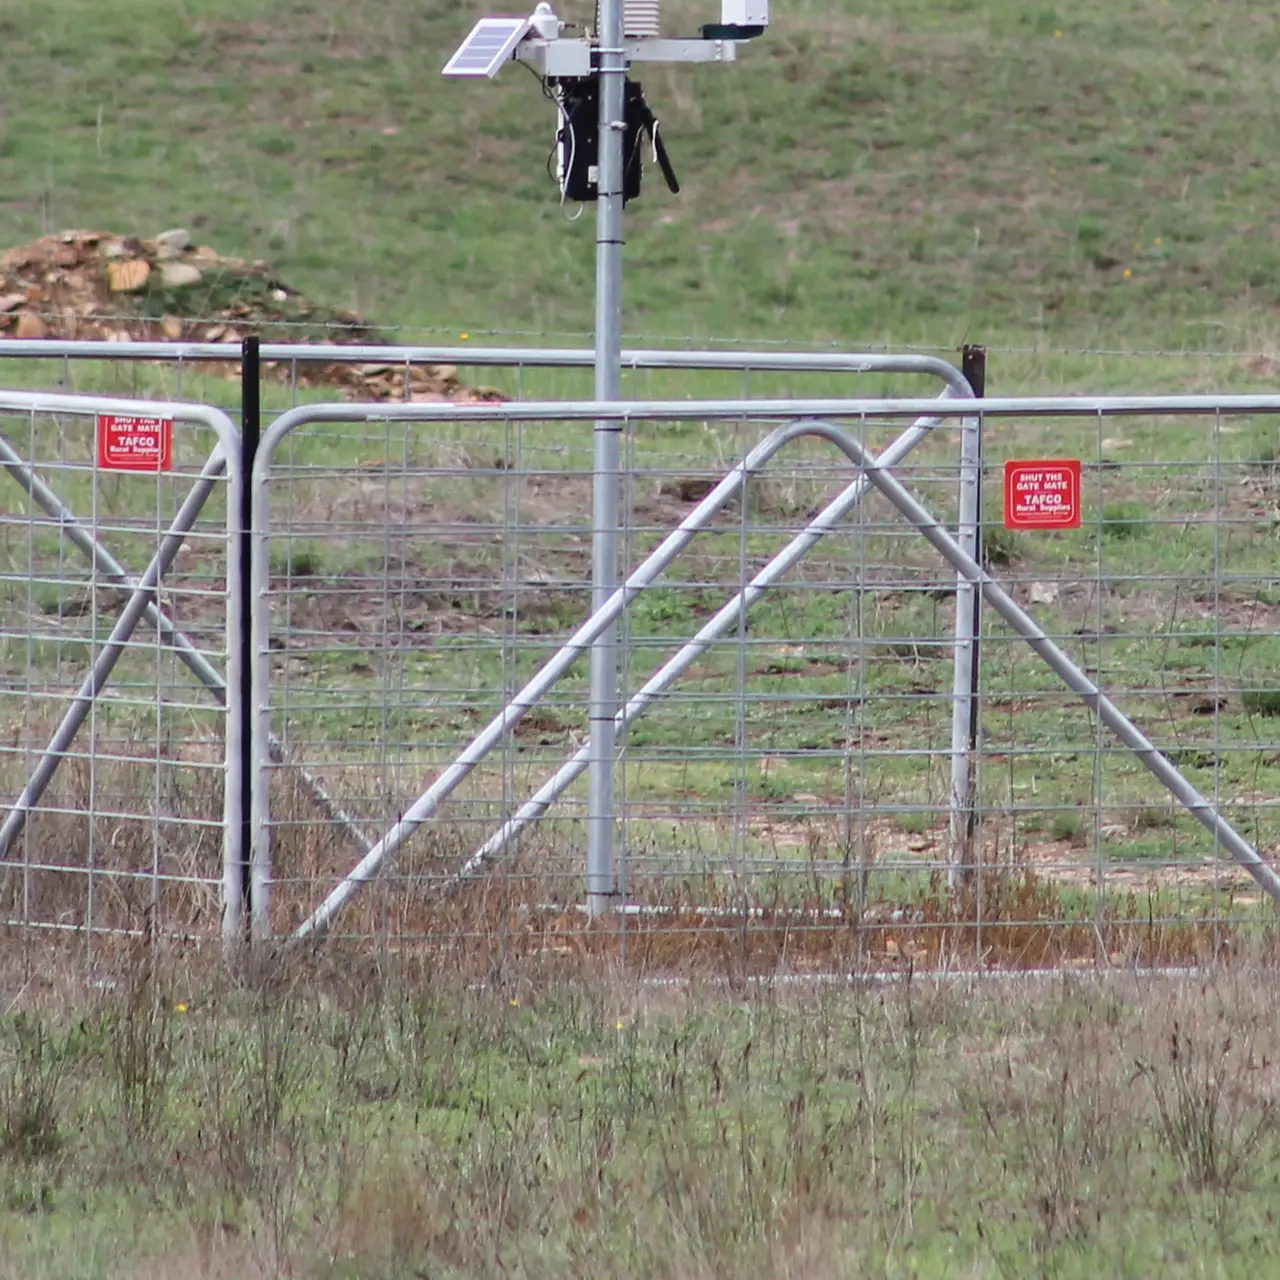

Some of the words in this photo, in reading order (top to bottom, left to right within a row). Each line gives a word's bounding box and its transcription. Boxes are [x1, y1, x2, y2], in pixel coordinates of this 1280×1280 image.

[111, 424, 133, 432] GATE
[137, 424, 159, 432] MATE
[118, 436, 154, 446] TAFCO
[1024, 494, 1062, 504] TAFCO
[1040, 504, 1071, 512] Supplies
